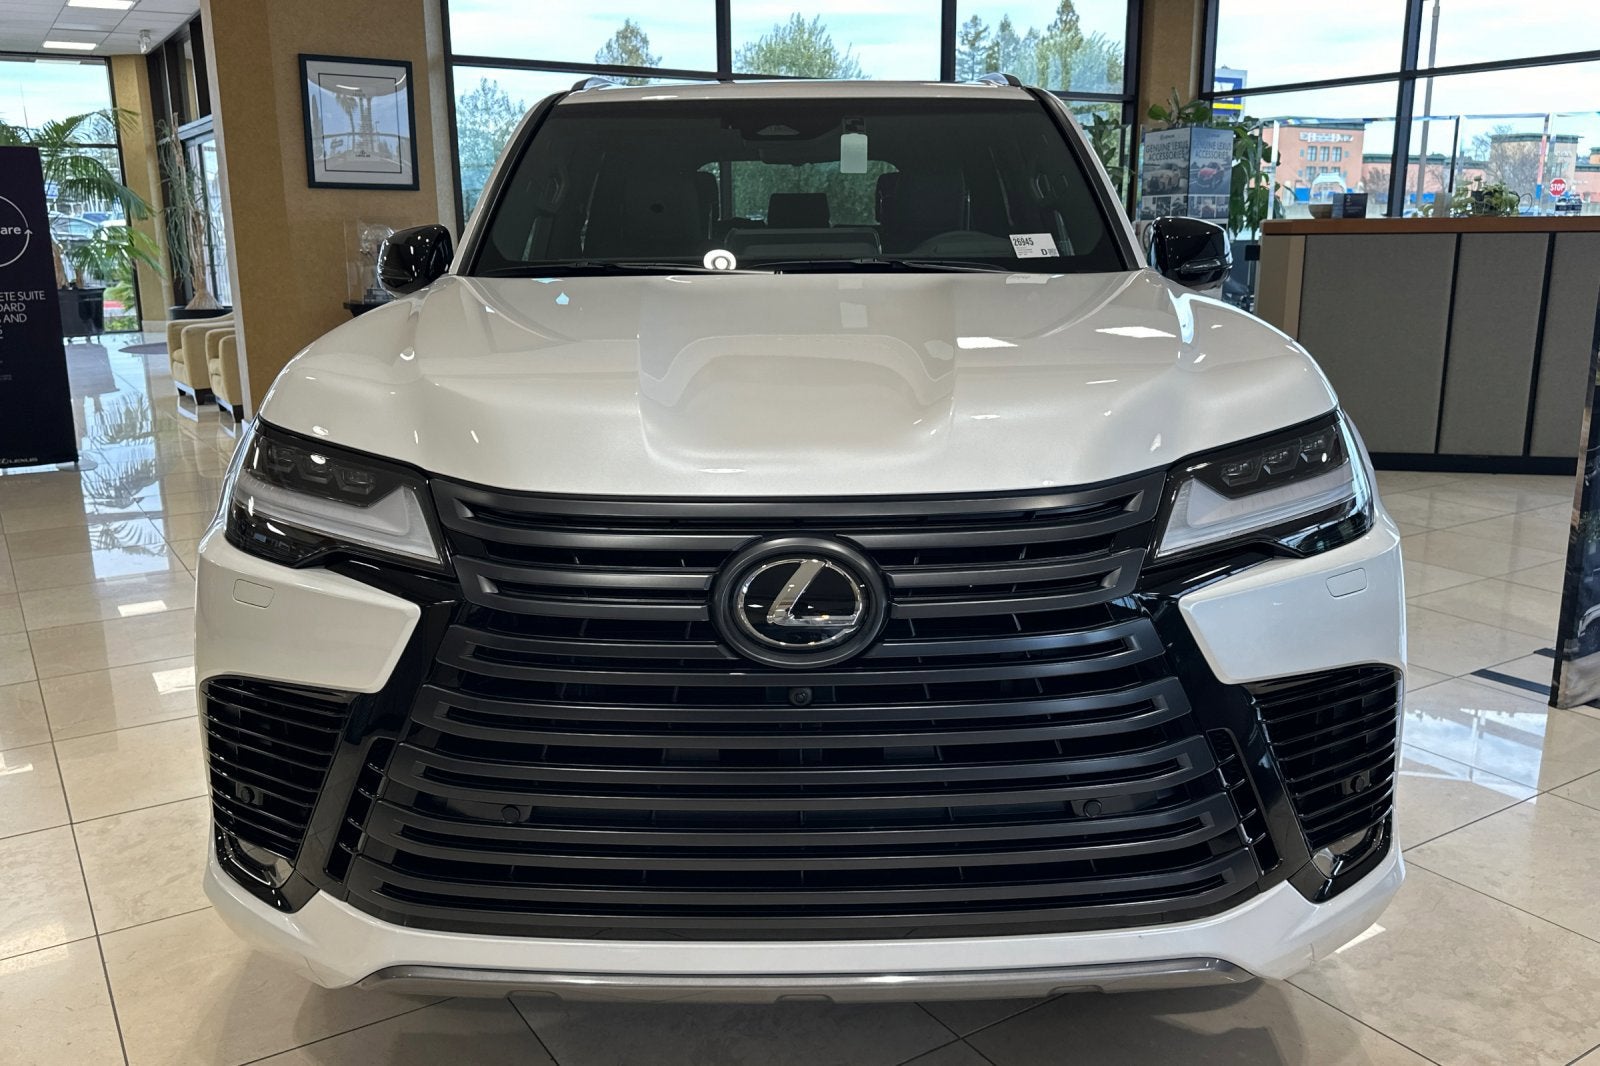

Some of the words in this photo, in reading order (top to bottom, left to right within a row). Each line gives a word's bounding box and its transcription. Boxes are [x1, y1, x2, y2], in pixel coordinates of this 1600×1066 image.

[1550, 183, 1565, 191] STOP
[1013, 237, 1034, 246] 26945
[17, 290, 46, 301] SUITE
[3, 313, 27, 323] AND
